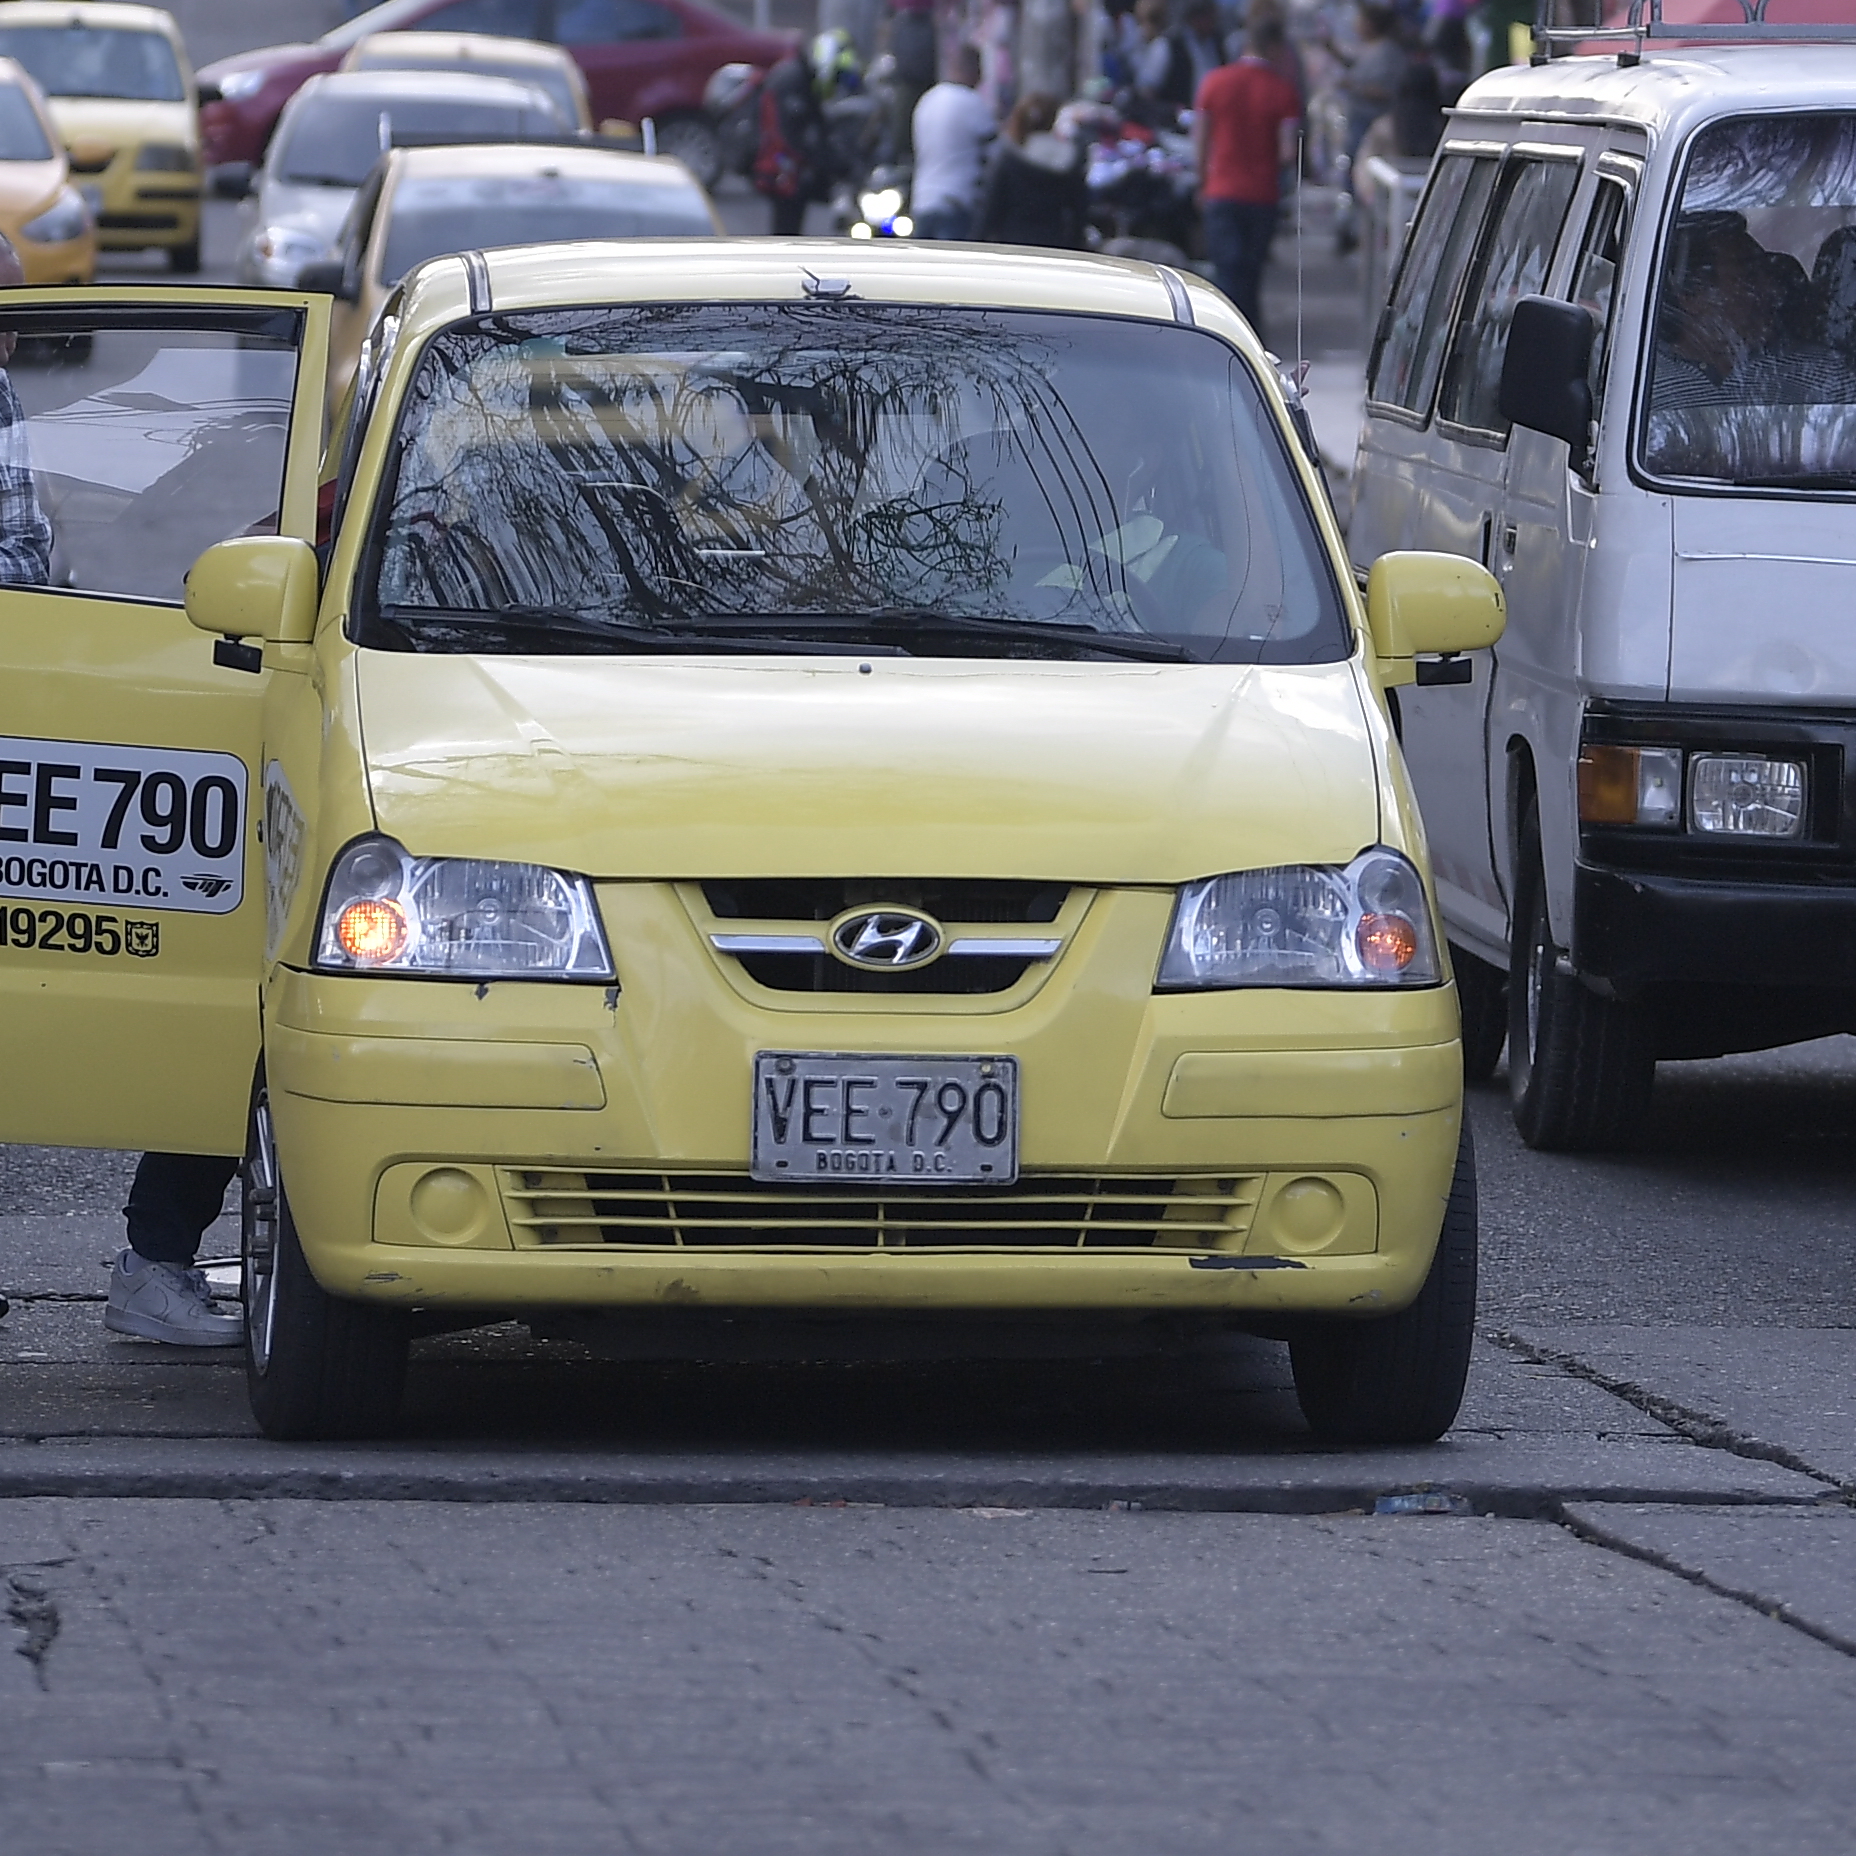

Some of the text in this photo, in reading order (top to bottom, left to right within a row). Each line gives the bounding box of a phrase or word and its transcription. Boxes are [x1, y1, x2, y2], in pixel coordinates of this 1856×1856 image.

[93, 767, 239, 858] 790
[113, 865, 170, 899] D.C.
[764, 1075, 1009, 1149] VEE 790
[816, 1148, 954, 1174] BOGOTA D.C.
